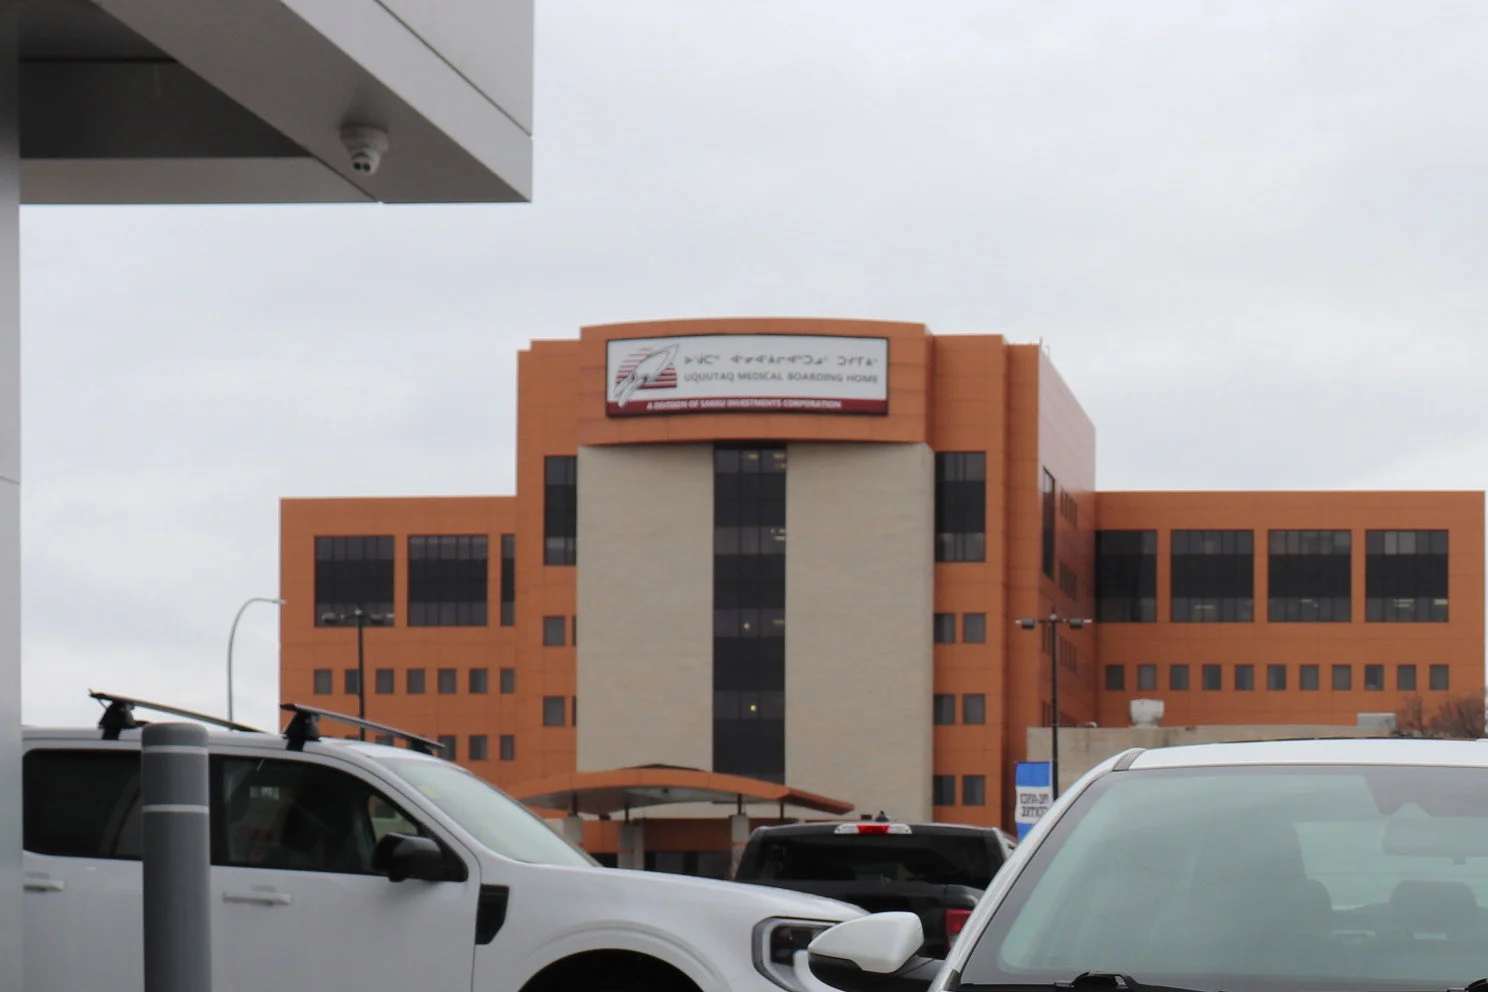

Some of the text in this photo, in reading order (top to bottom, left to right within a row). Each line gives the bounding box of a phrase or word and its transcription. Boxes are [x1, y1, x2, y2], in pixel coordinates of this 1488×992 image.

[684, 372, 879, 384] UQUUTAQ MEDICAL BOARDING HOME
[688, 400, 699, 409] OF
[727, 399, 781, 408] INVESTMENTS
[782, 399, 842, 409] CORPORATION
